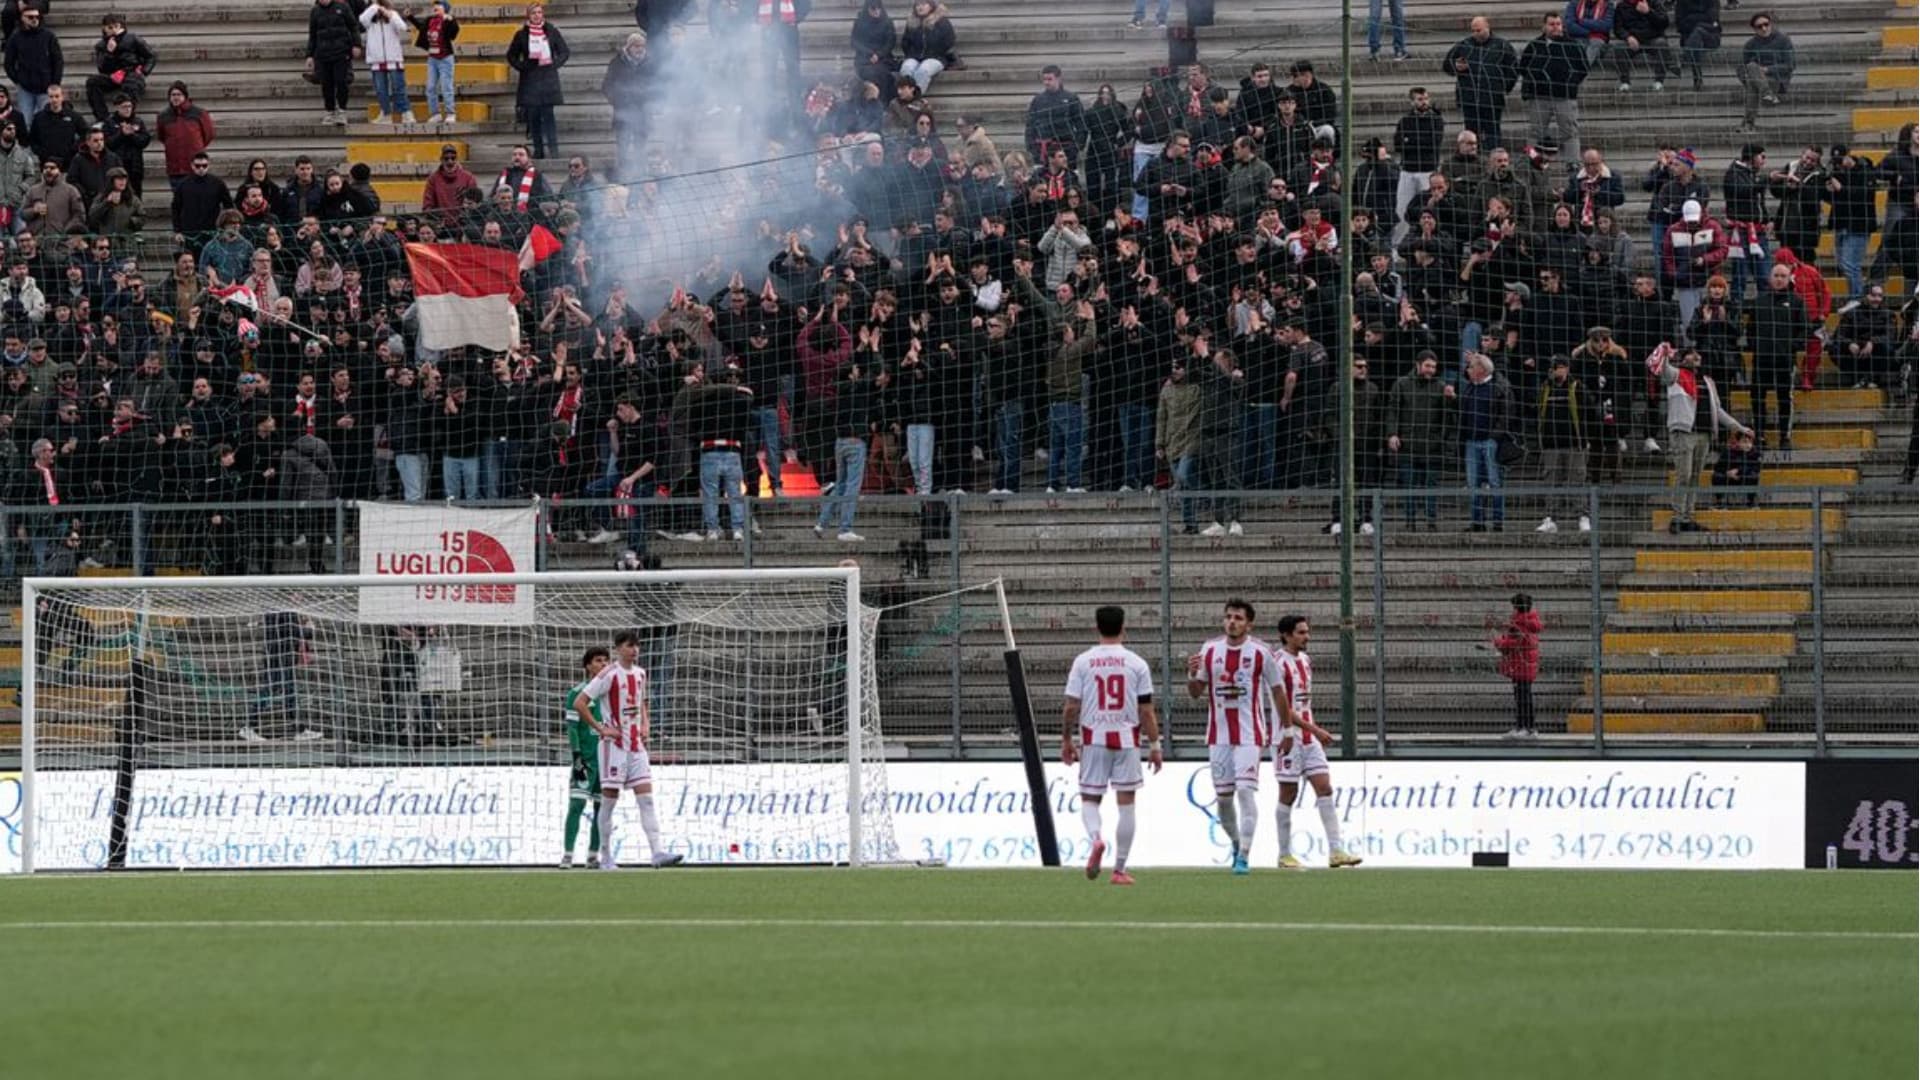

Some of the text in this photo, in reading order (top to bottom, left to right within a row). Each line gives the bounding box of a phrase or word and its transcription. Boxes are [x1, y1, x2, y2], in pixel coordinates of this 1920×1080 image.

[440, 531, 465, 552] 15
[376, 552, 465, 575] LUGLIO
[416, 583, 463, 601] 1913
[1094, 673, 1125, 711] 19
[91, 778, 499, 831] Ipianti termoidraulici
[676, 782, 831, 829] Impianti
[1473, 771, 1738, 809] termoidraulici
[772, 832, 899, 861] Gabrele
[1395, 828, 1531, 857] Gabriele
[1550, 832, 1755, 861] 347.6784920
